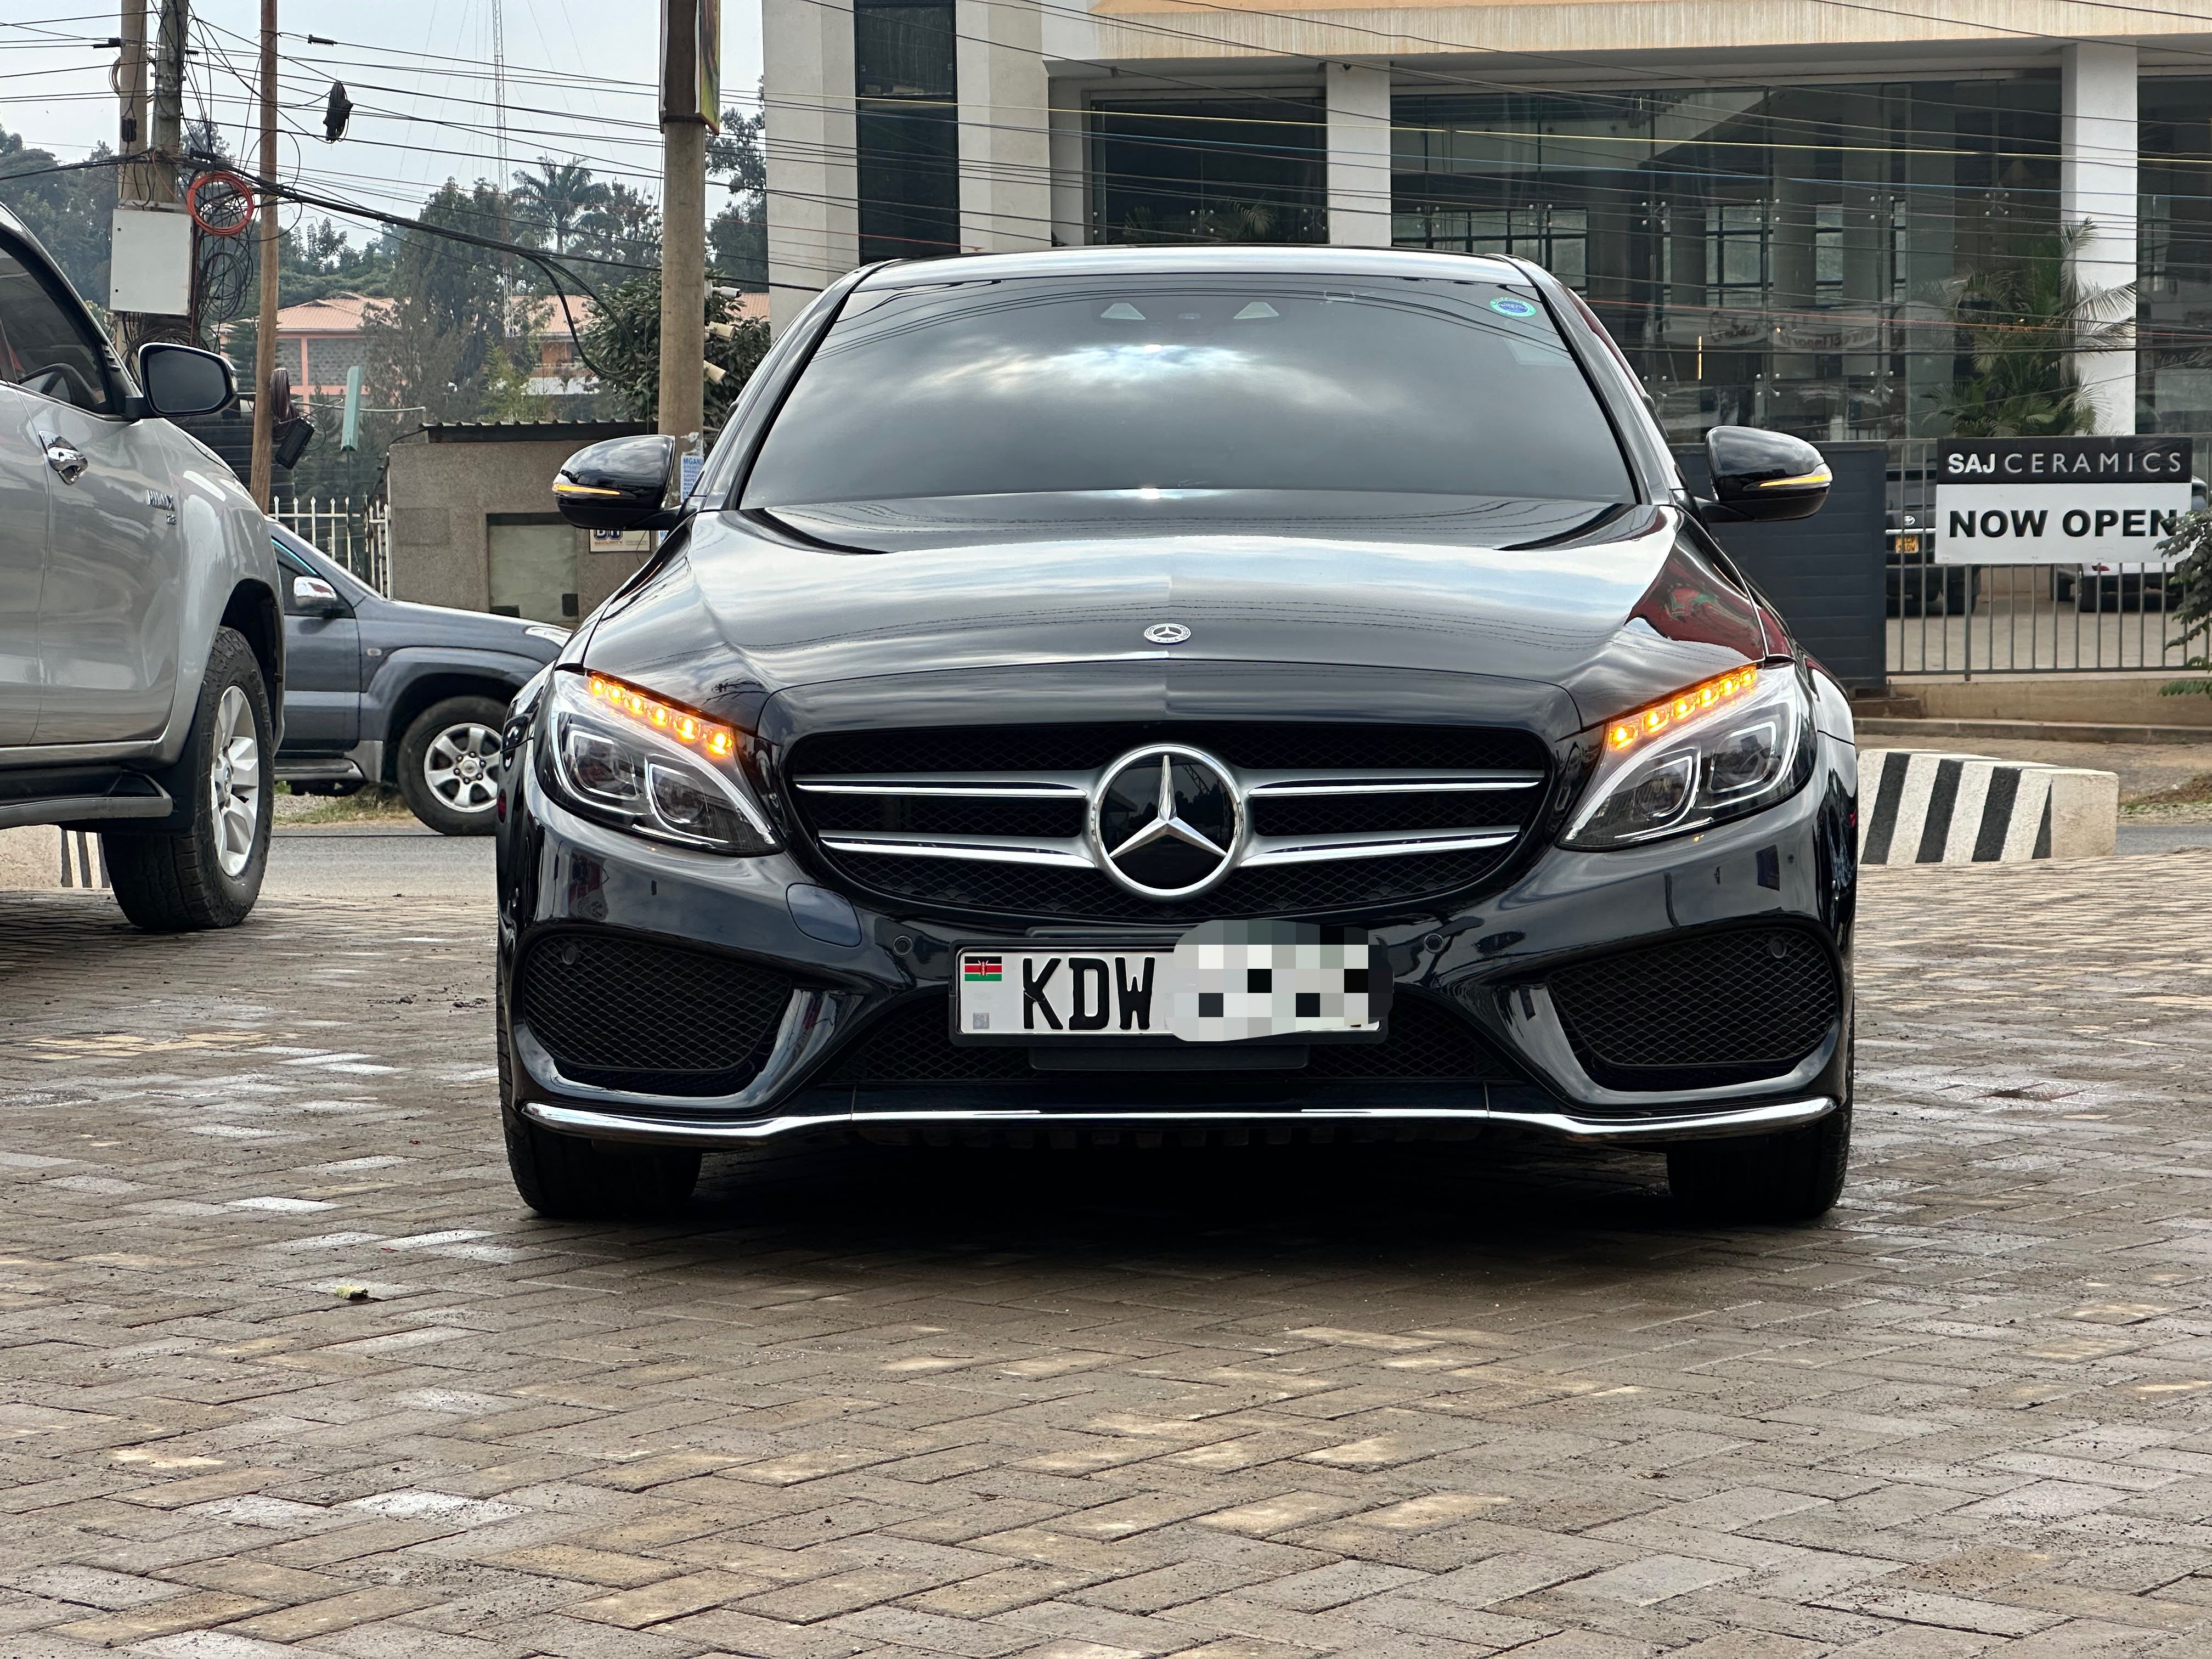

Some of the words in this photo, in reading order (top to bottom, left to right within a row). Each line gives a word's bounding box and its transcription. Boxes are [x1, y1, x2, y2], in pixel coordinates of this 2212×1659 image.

[1949, 454, 1995, 473] SAJ
[2005, 453, 2180, 473] CERAMICS
[1950, 510, 2047, 538] NOW
[2063, 509, 2177, 537] OPEN
[1023, 957, 1155, 1030] KDW
